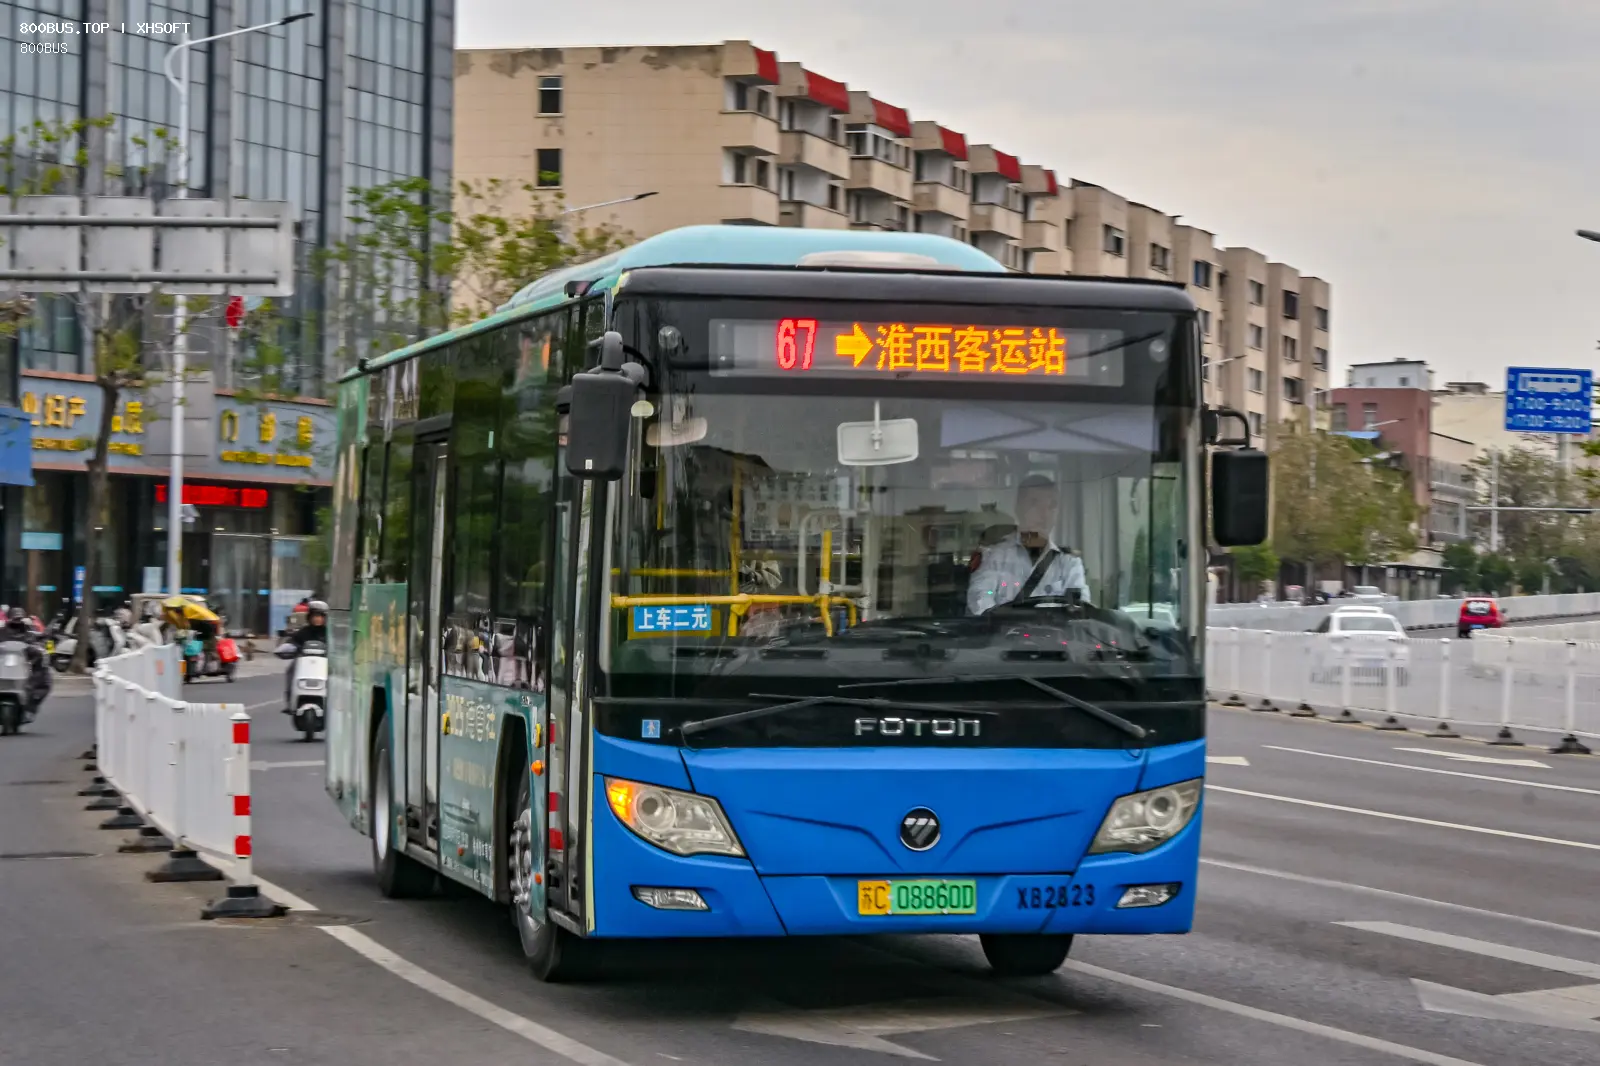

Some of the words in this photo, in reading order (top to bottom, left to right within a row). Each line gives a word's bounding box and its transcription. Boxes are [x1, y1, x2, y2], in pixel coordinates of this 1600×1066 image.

[776, 318, 818, 370] 67
[875, 323, 1066, 375] 淮西客运站
[638, 607, 708, 630] 上车二元
[853, 717, 981, 737] FOTON
